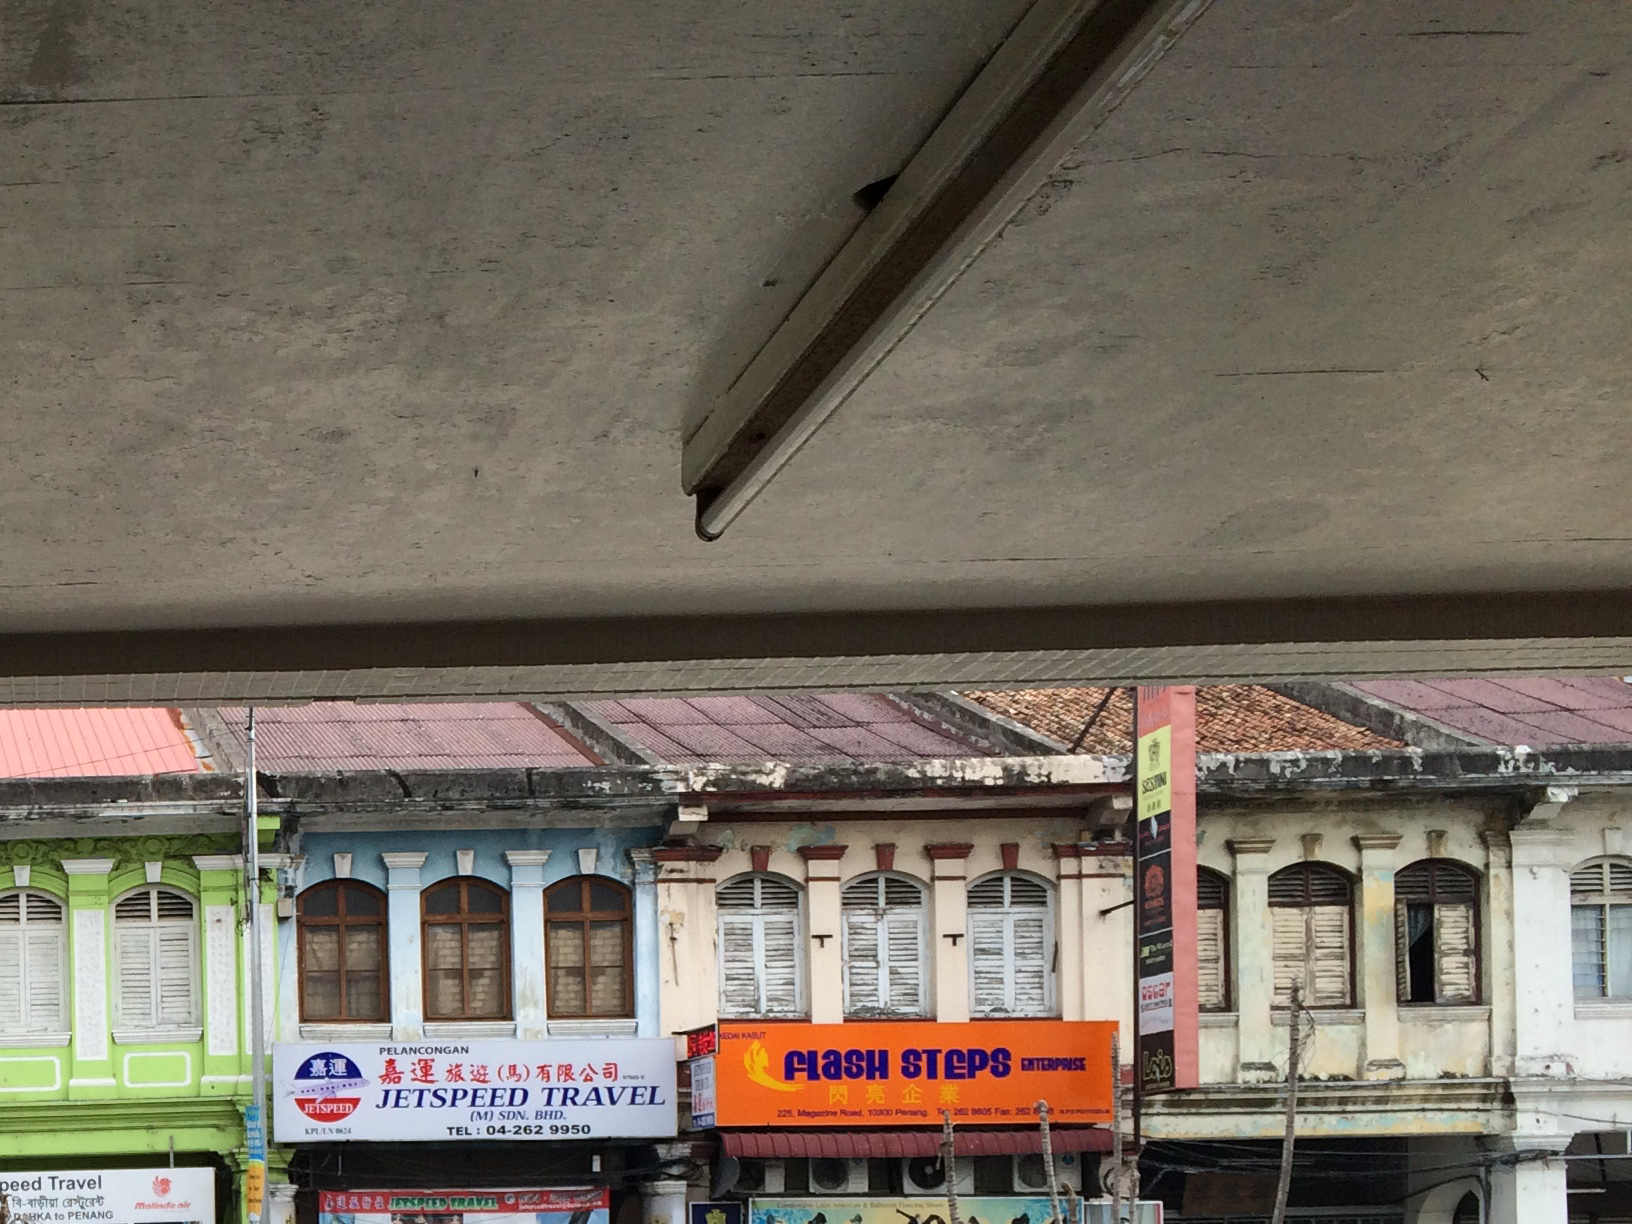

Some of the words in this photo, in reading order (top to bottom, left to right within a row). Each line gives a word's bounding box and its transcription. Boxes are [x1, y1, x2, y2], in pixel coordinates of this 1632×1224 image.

[379, 1046, 469, 1056] PELANCONGAN
[1020, 1057, 1087, 1072] ENTERPRISE
[375, 1087, 529, 1109] JETSPEED
[541, 1085, 666, 1107] TRAVEL
[303, 1103, 354, 1114] JETSPEED
[470, 1110, 494, 1122] (M)
[497, 1110, 530, 1121] SDN.
[534, 1110, 567, 1121] BHD.
[486, 1125, 544, 1136] 04-262
[549, 1124, 591, 1135] 9950
[47, 1174, 102, 1191] Travel
[388, 1195, 448, 1211] JETSPEED
[54, 1212, 65, 1221] to
[68, 1210, 114, 1220] PENANG
